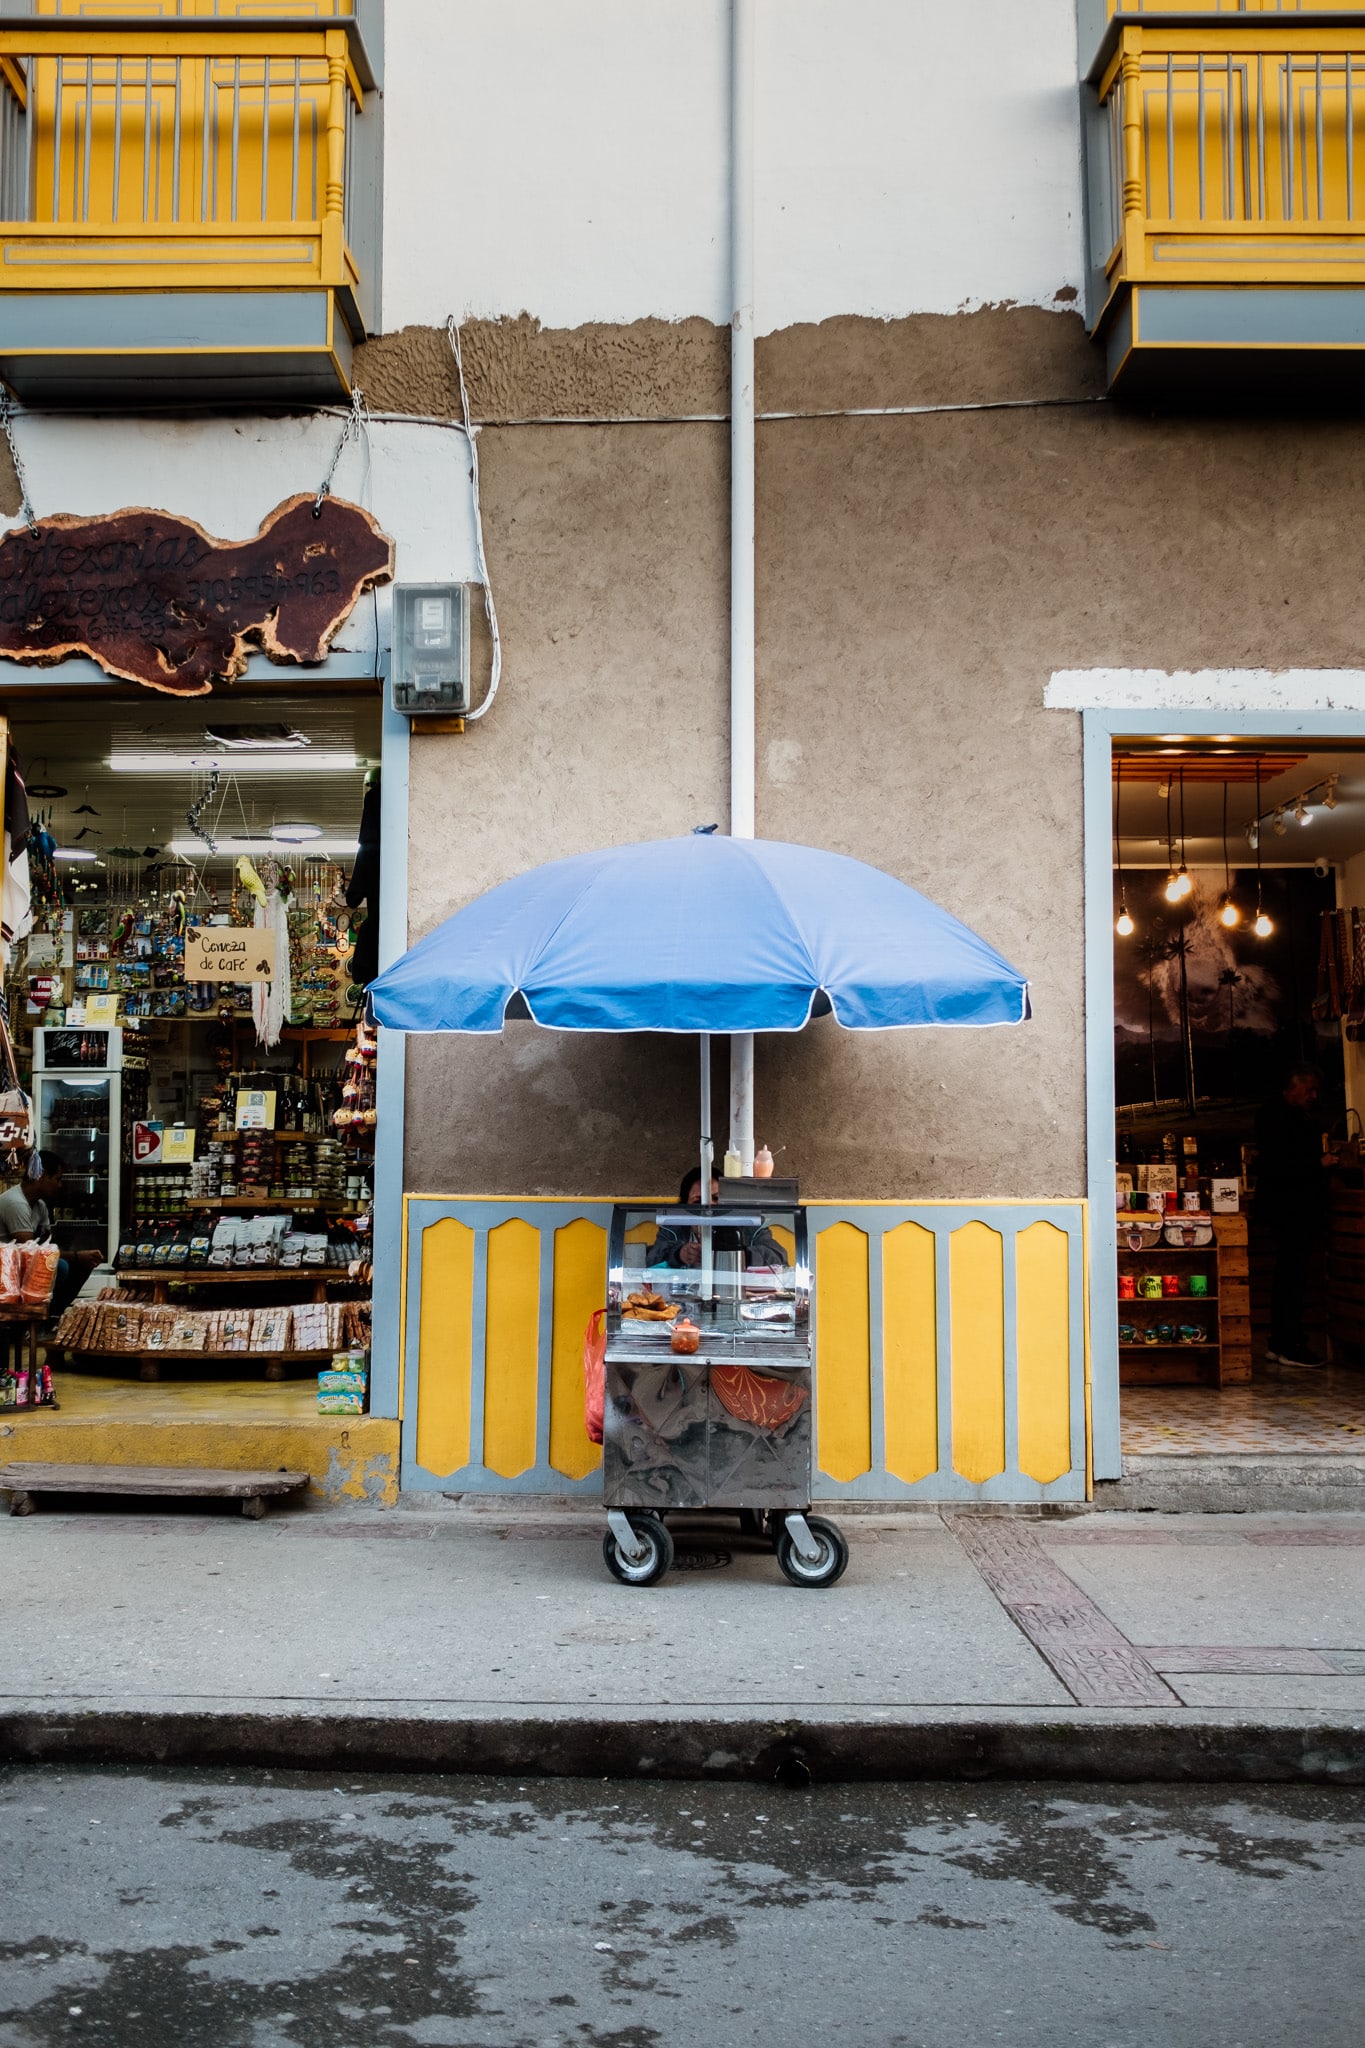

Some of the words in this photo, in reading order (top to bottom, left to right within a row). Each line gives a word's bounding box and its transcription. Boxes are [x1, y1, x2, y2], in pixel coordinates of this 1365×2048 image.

[0, 579, 172, 634] afeteras
[201, 936, 246, 953] Cerveza
[199, 956, 214, 970] de
